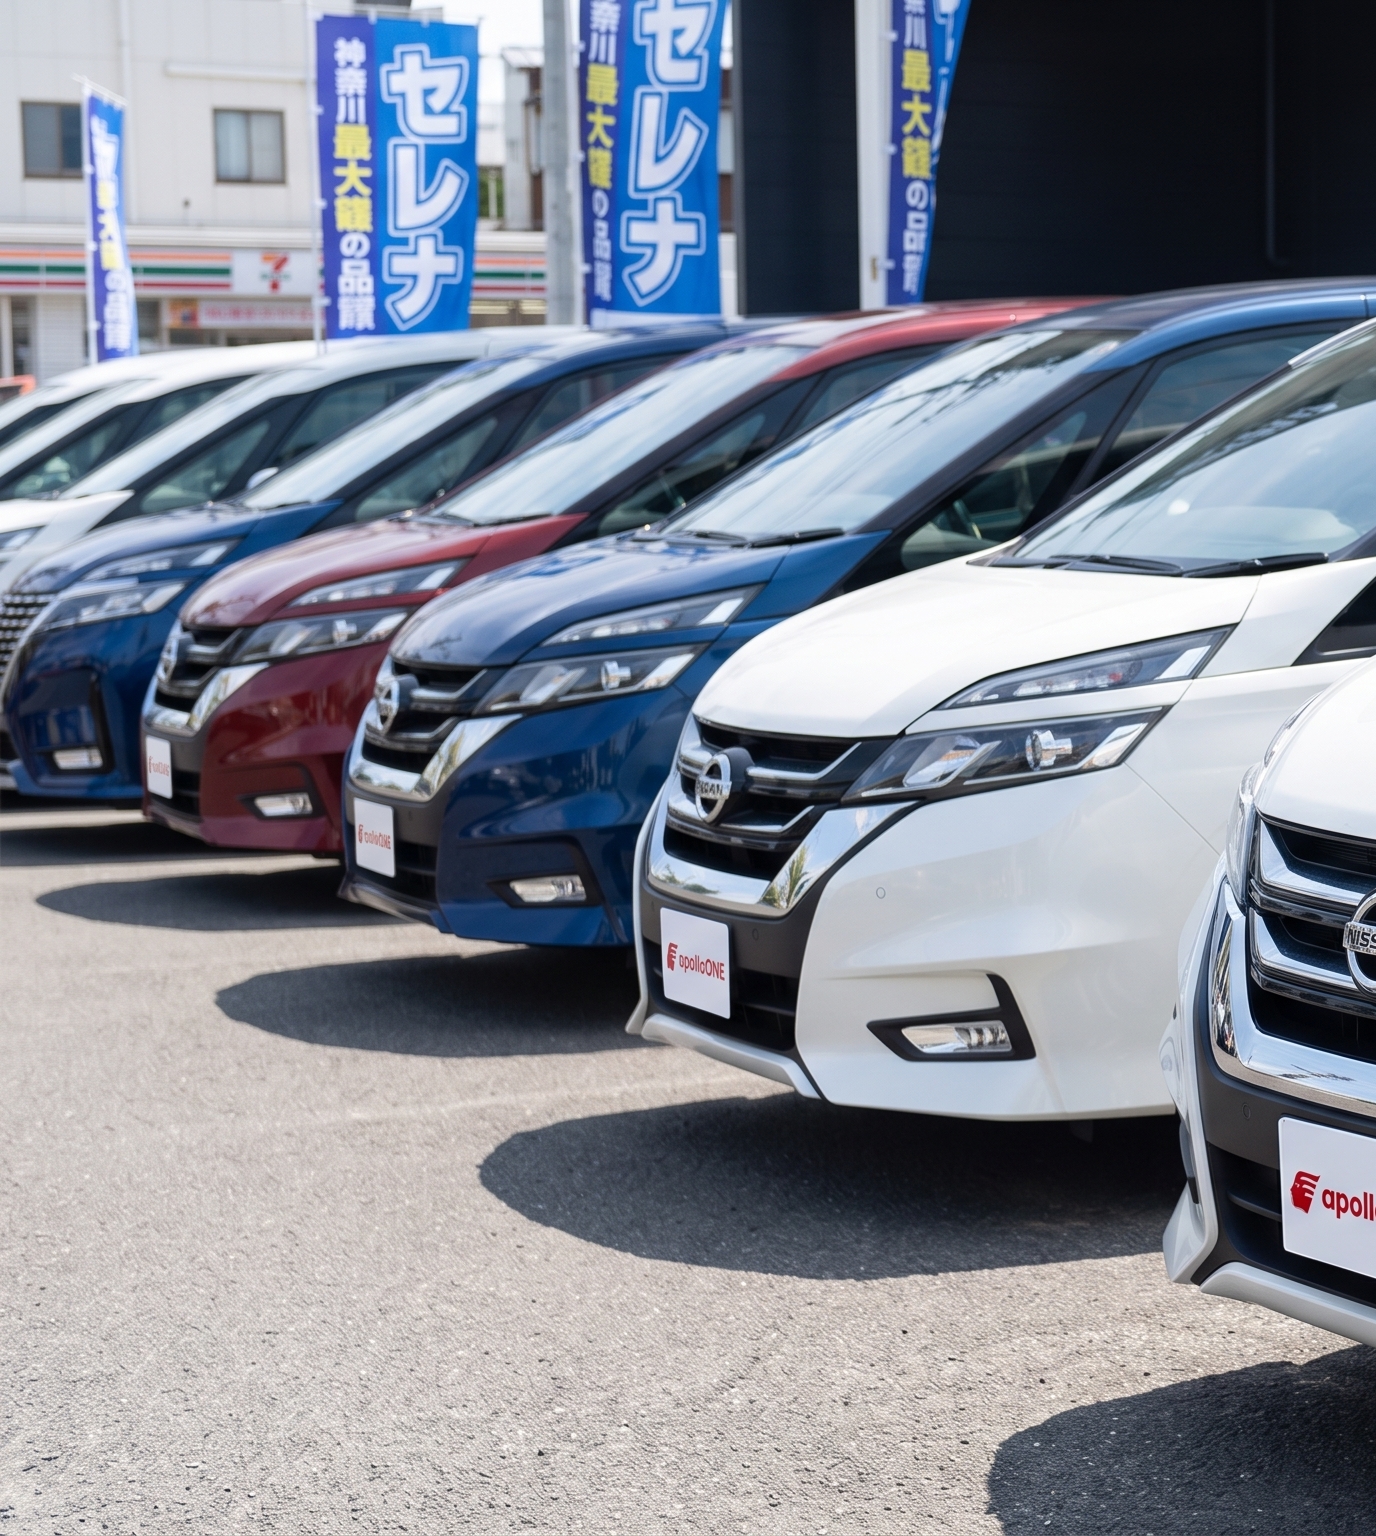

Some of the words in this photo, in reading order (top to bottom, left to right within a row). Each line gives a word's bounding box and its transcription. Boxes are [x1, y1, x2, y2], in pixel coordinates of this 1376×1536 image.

[380, 43, 470, 330] セレナ
[620, 0, 719, 307] セレナ
[679, 954, 725, 981] apolloONE
